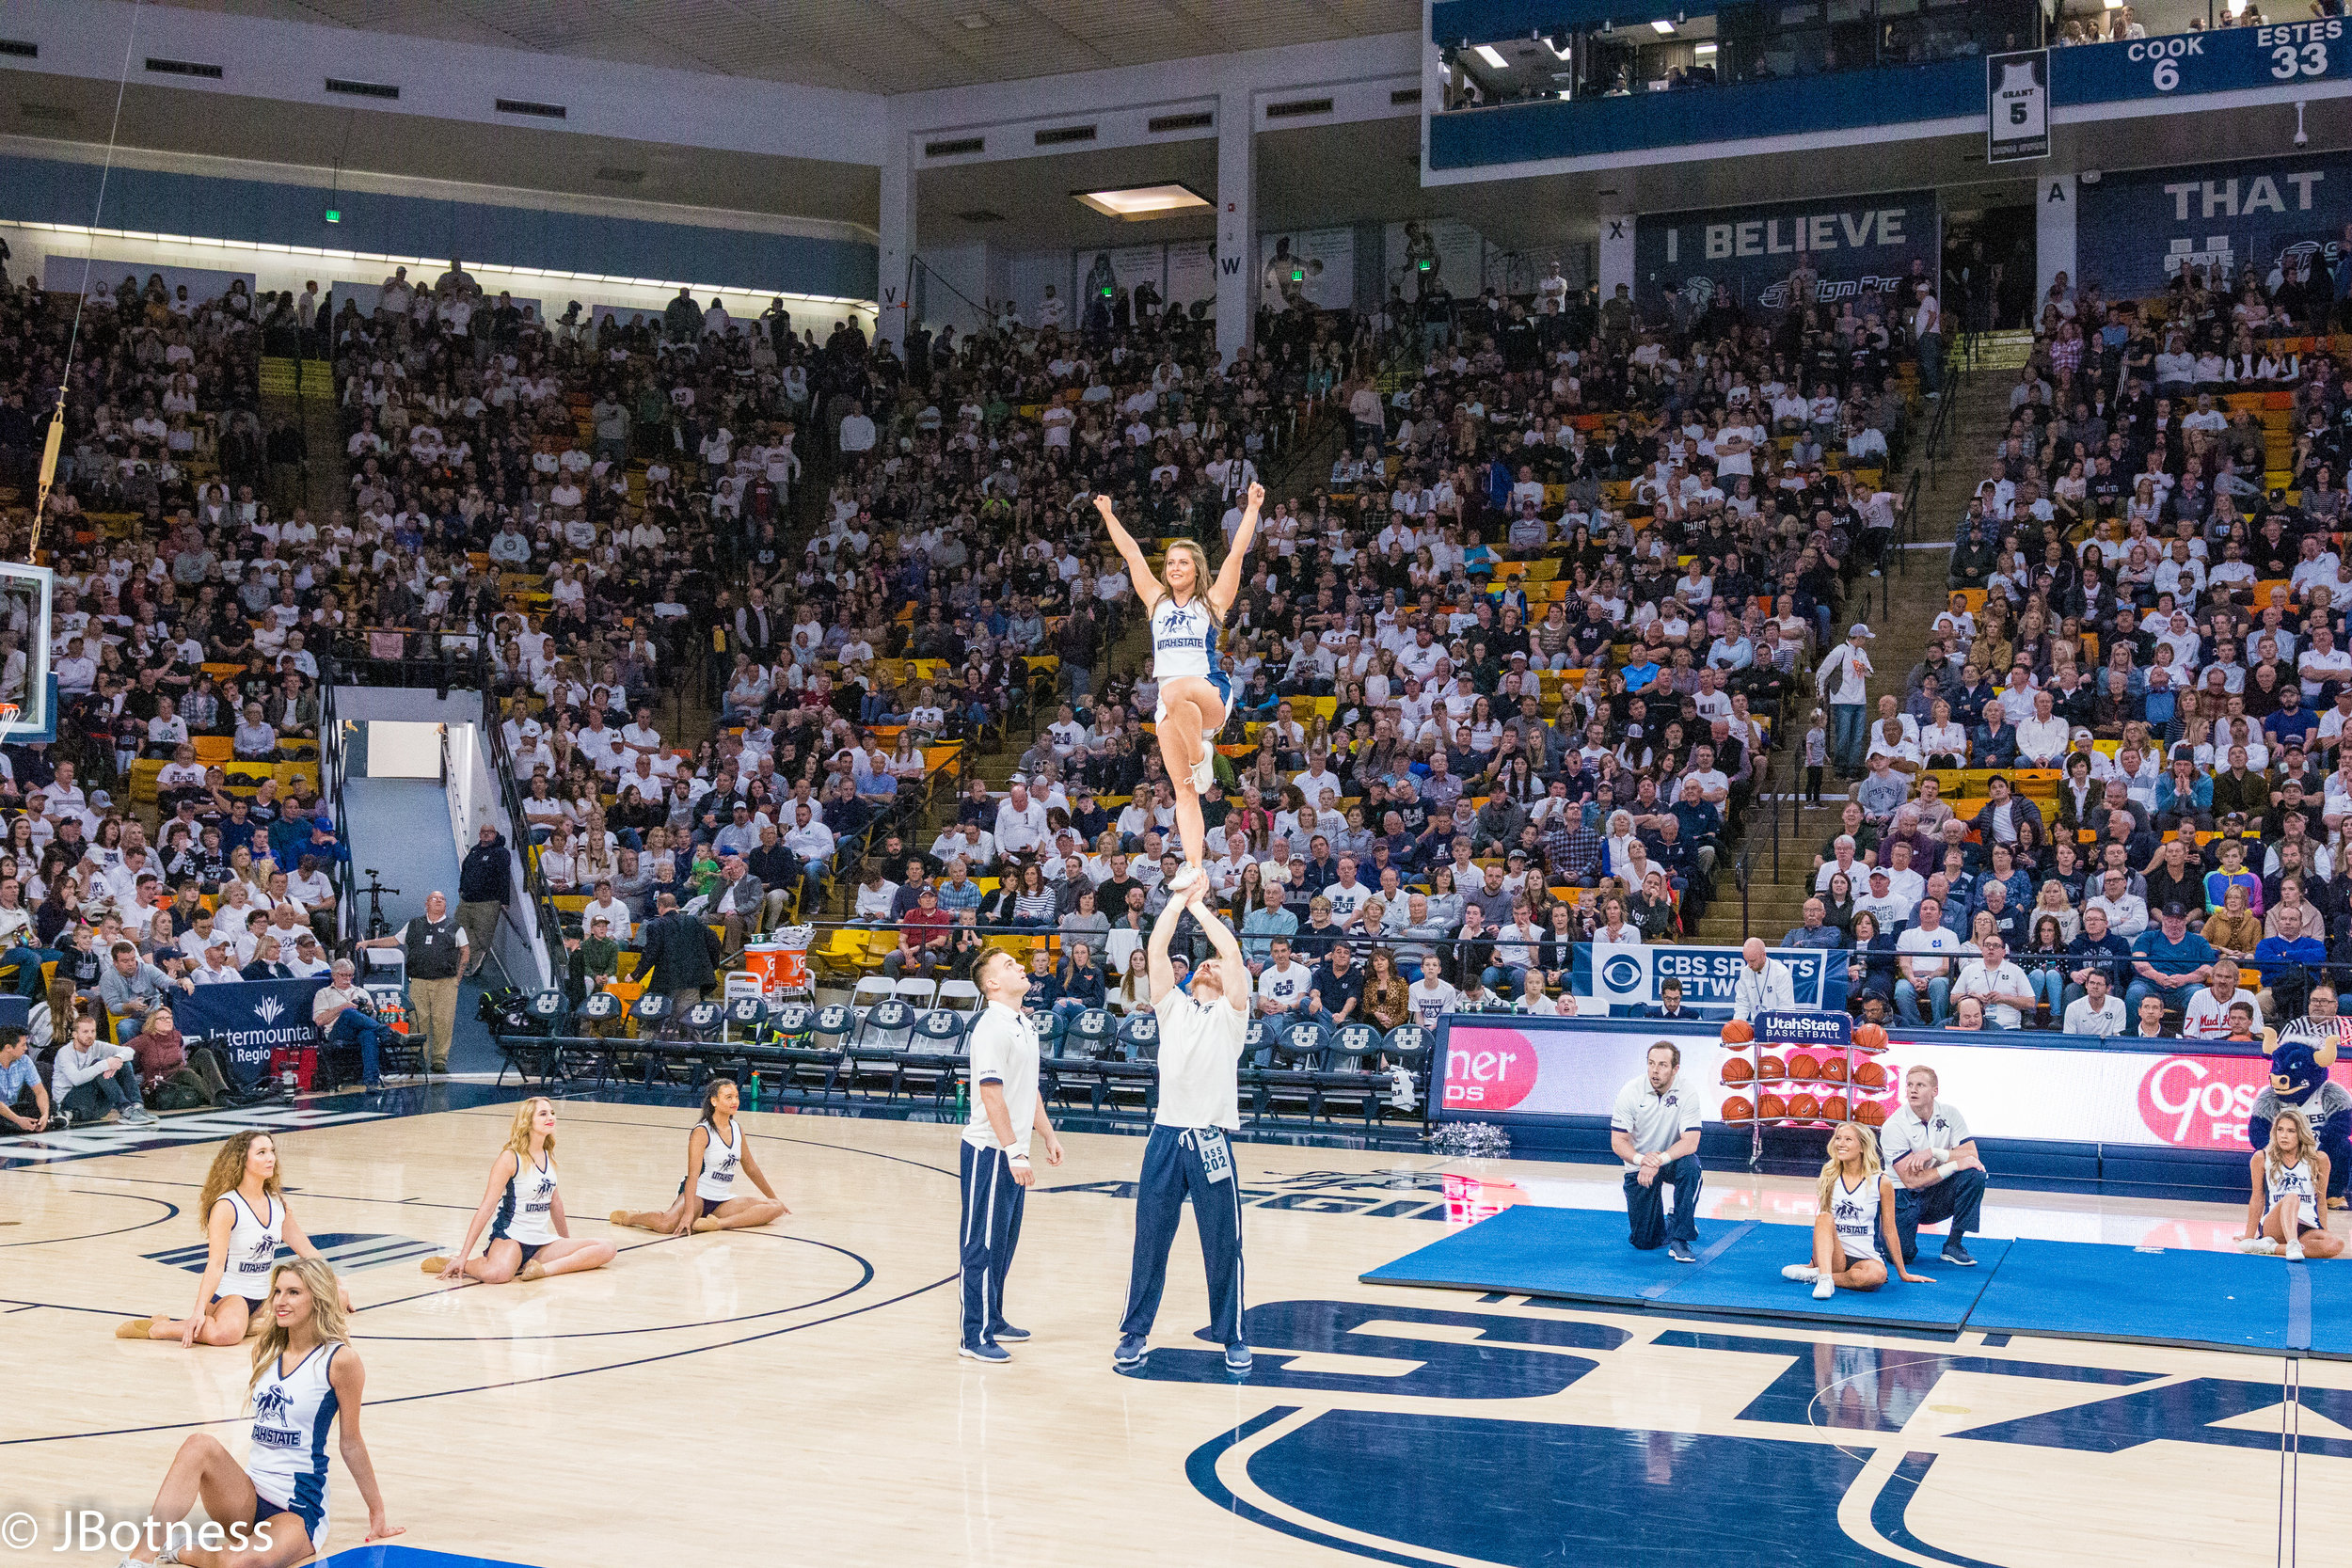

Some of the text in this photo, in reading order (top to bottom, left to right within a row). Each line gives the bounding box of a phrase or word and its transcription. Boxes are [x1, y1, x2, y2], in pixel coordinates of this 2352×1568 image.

[2257, 21, 2343, 48] ESTES
[2128, 37, 2204, 62] COOK
[2271, 42, 2328, 79] 33
[2153, 58, 2180, 91] 6
[2001, 88, 2034, 99] GRANT
[2010, 102, 2028, 125] 5
[2047, 182, 2066, 202] A
[2165, 171, 2325, 221] THAT
[1609, 221, 1625, 240] X
[1667, 208, 1907, 262] I BELIEVE
[1219, 256, 1241, 276] W
[1420, 260, 1430, 268] EXIT
[1291, 270, 1302, 279] EXIT
[884, 286, 896, 303] V
[1157, 638, 1204, 651] UTAH STATE
[1330, 900, 1355, 909] STATE
[766, 957, 775, 971] G
[798, 955, 804, 968] G
[1658, 956, 1815, 978] CBS SPTS
[1766, 1017, 1840, 1032] UtahState
[2185, 1017, 2193, 1030] 7
[2200, 1014, 2218, 1026] Mud
[210, 1023, 315, 1047] Intermounta
[1766, 1029, 1841, 1039] BASKETBALL
[237, 1045, 272, 1065] Regio
[1446, 1048, 1517, 1083] ner
[1445, 1085, 1485, 1101] DS
[2308, 1114, 2326, 1124] ES
[1200, 1128, 1219, 1138] STATE
[1204, 1147, 1222, 1161] ASS
[1203, 1156, 1227, 1174] 202
[525, 1202, 543, 1212] UTAH
[1846, 1224, 1868, 1234] STATE
[239, 1261, 260, 1273] UTAH
[251, 1423, 301, 1447] TAH STATE
